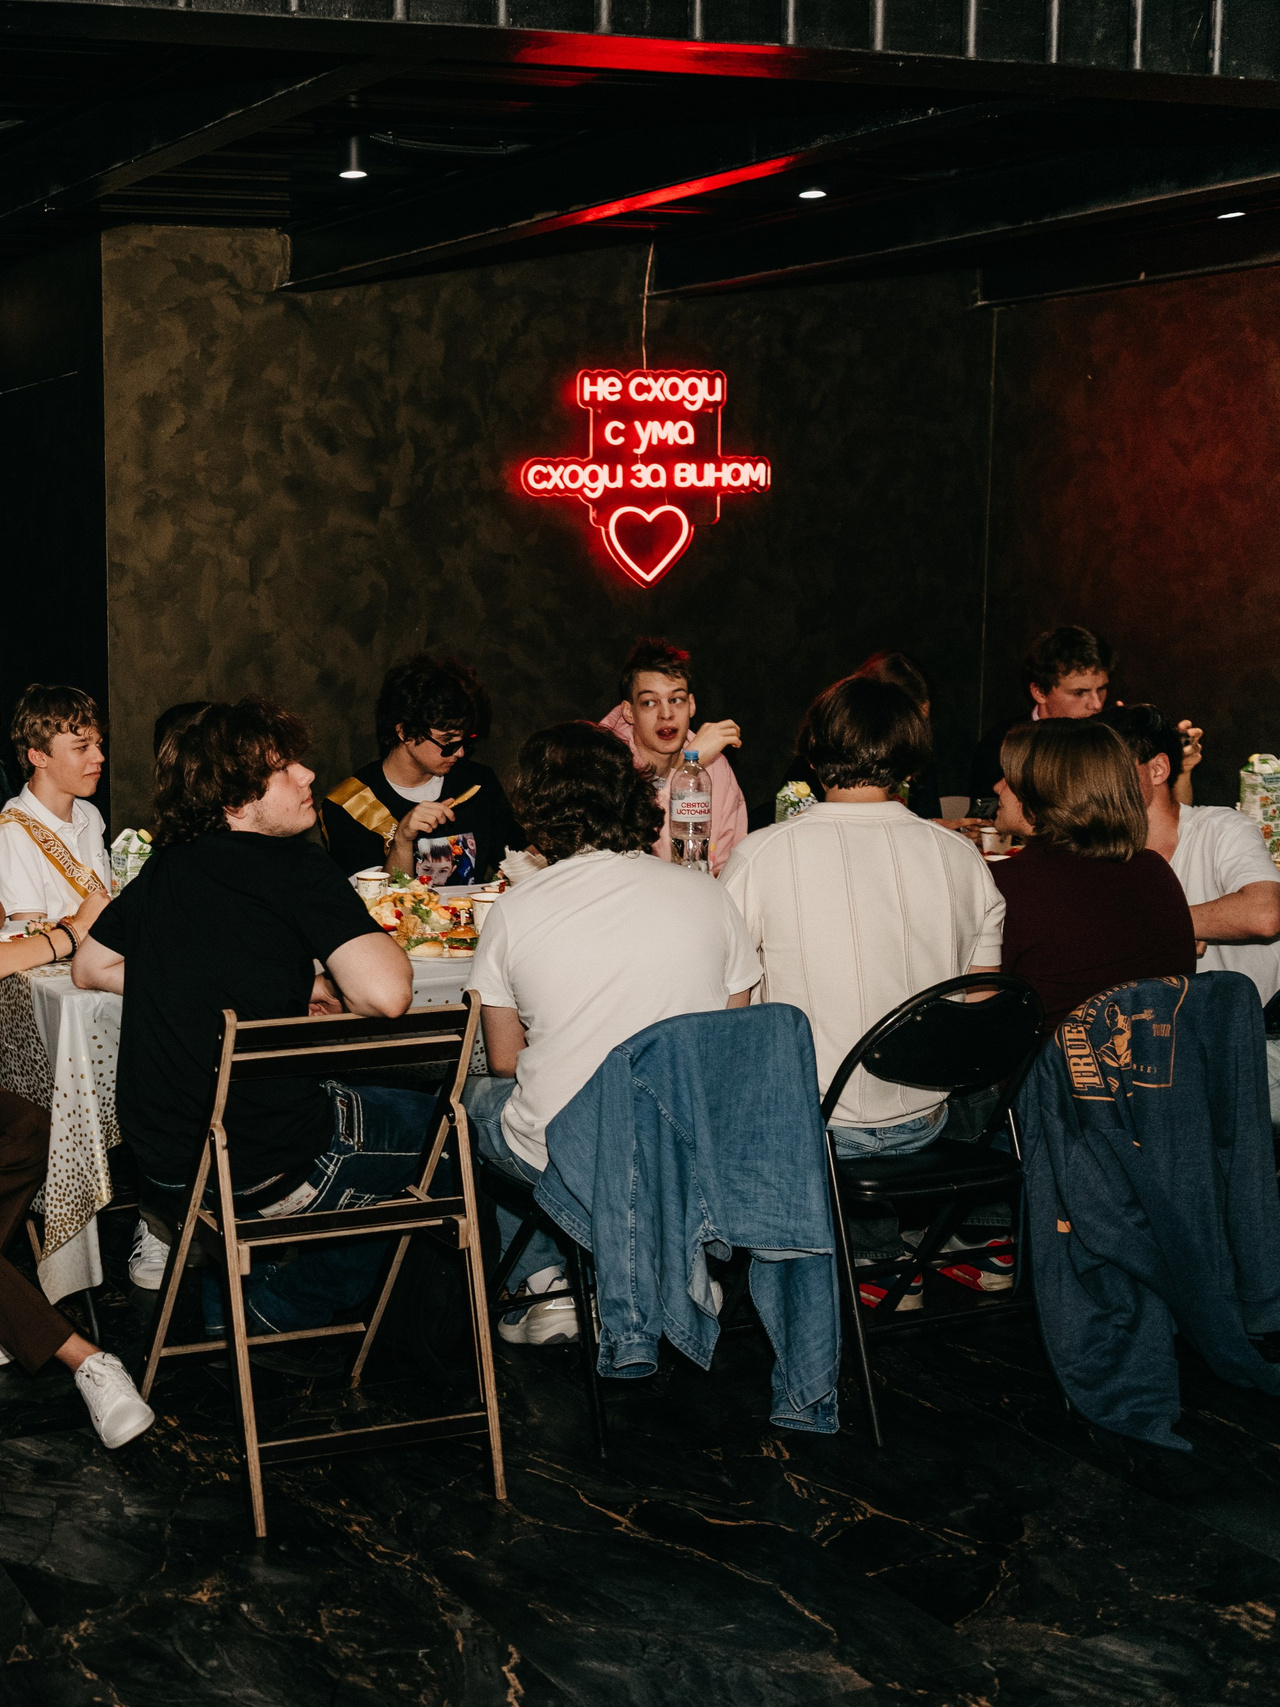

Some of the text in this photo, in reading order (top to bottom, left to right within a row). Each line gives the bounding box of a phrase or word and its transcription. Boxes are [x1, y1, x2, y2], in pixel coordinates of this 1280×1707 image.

[628, 376, 722, 411] сходи
[604, 420, 695, 454] с ума
[527, 463, 623, 498] сходи
[630, 463, 667, 488] за
[1063, 1024, 1103, 1089] TRUE
